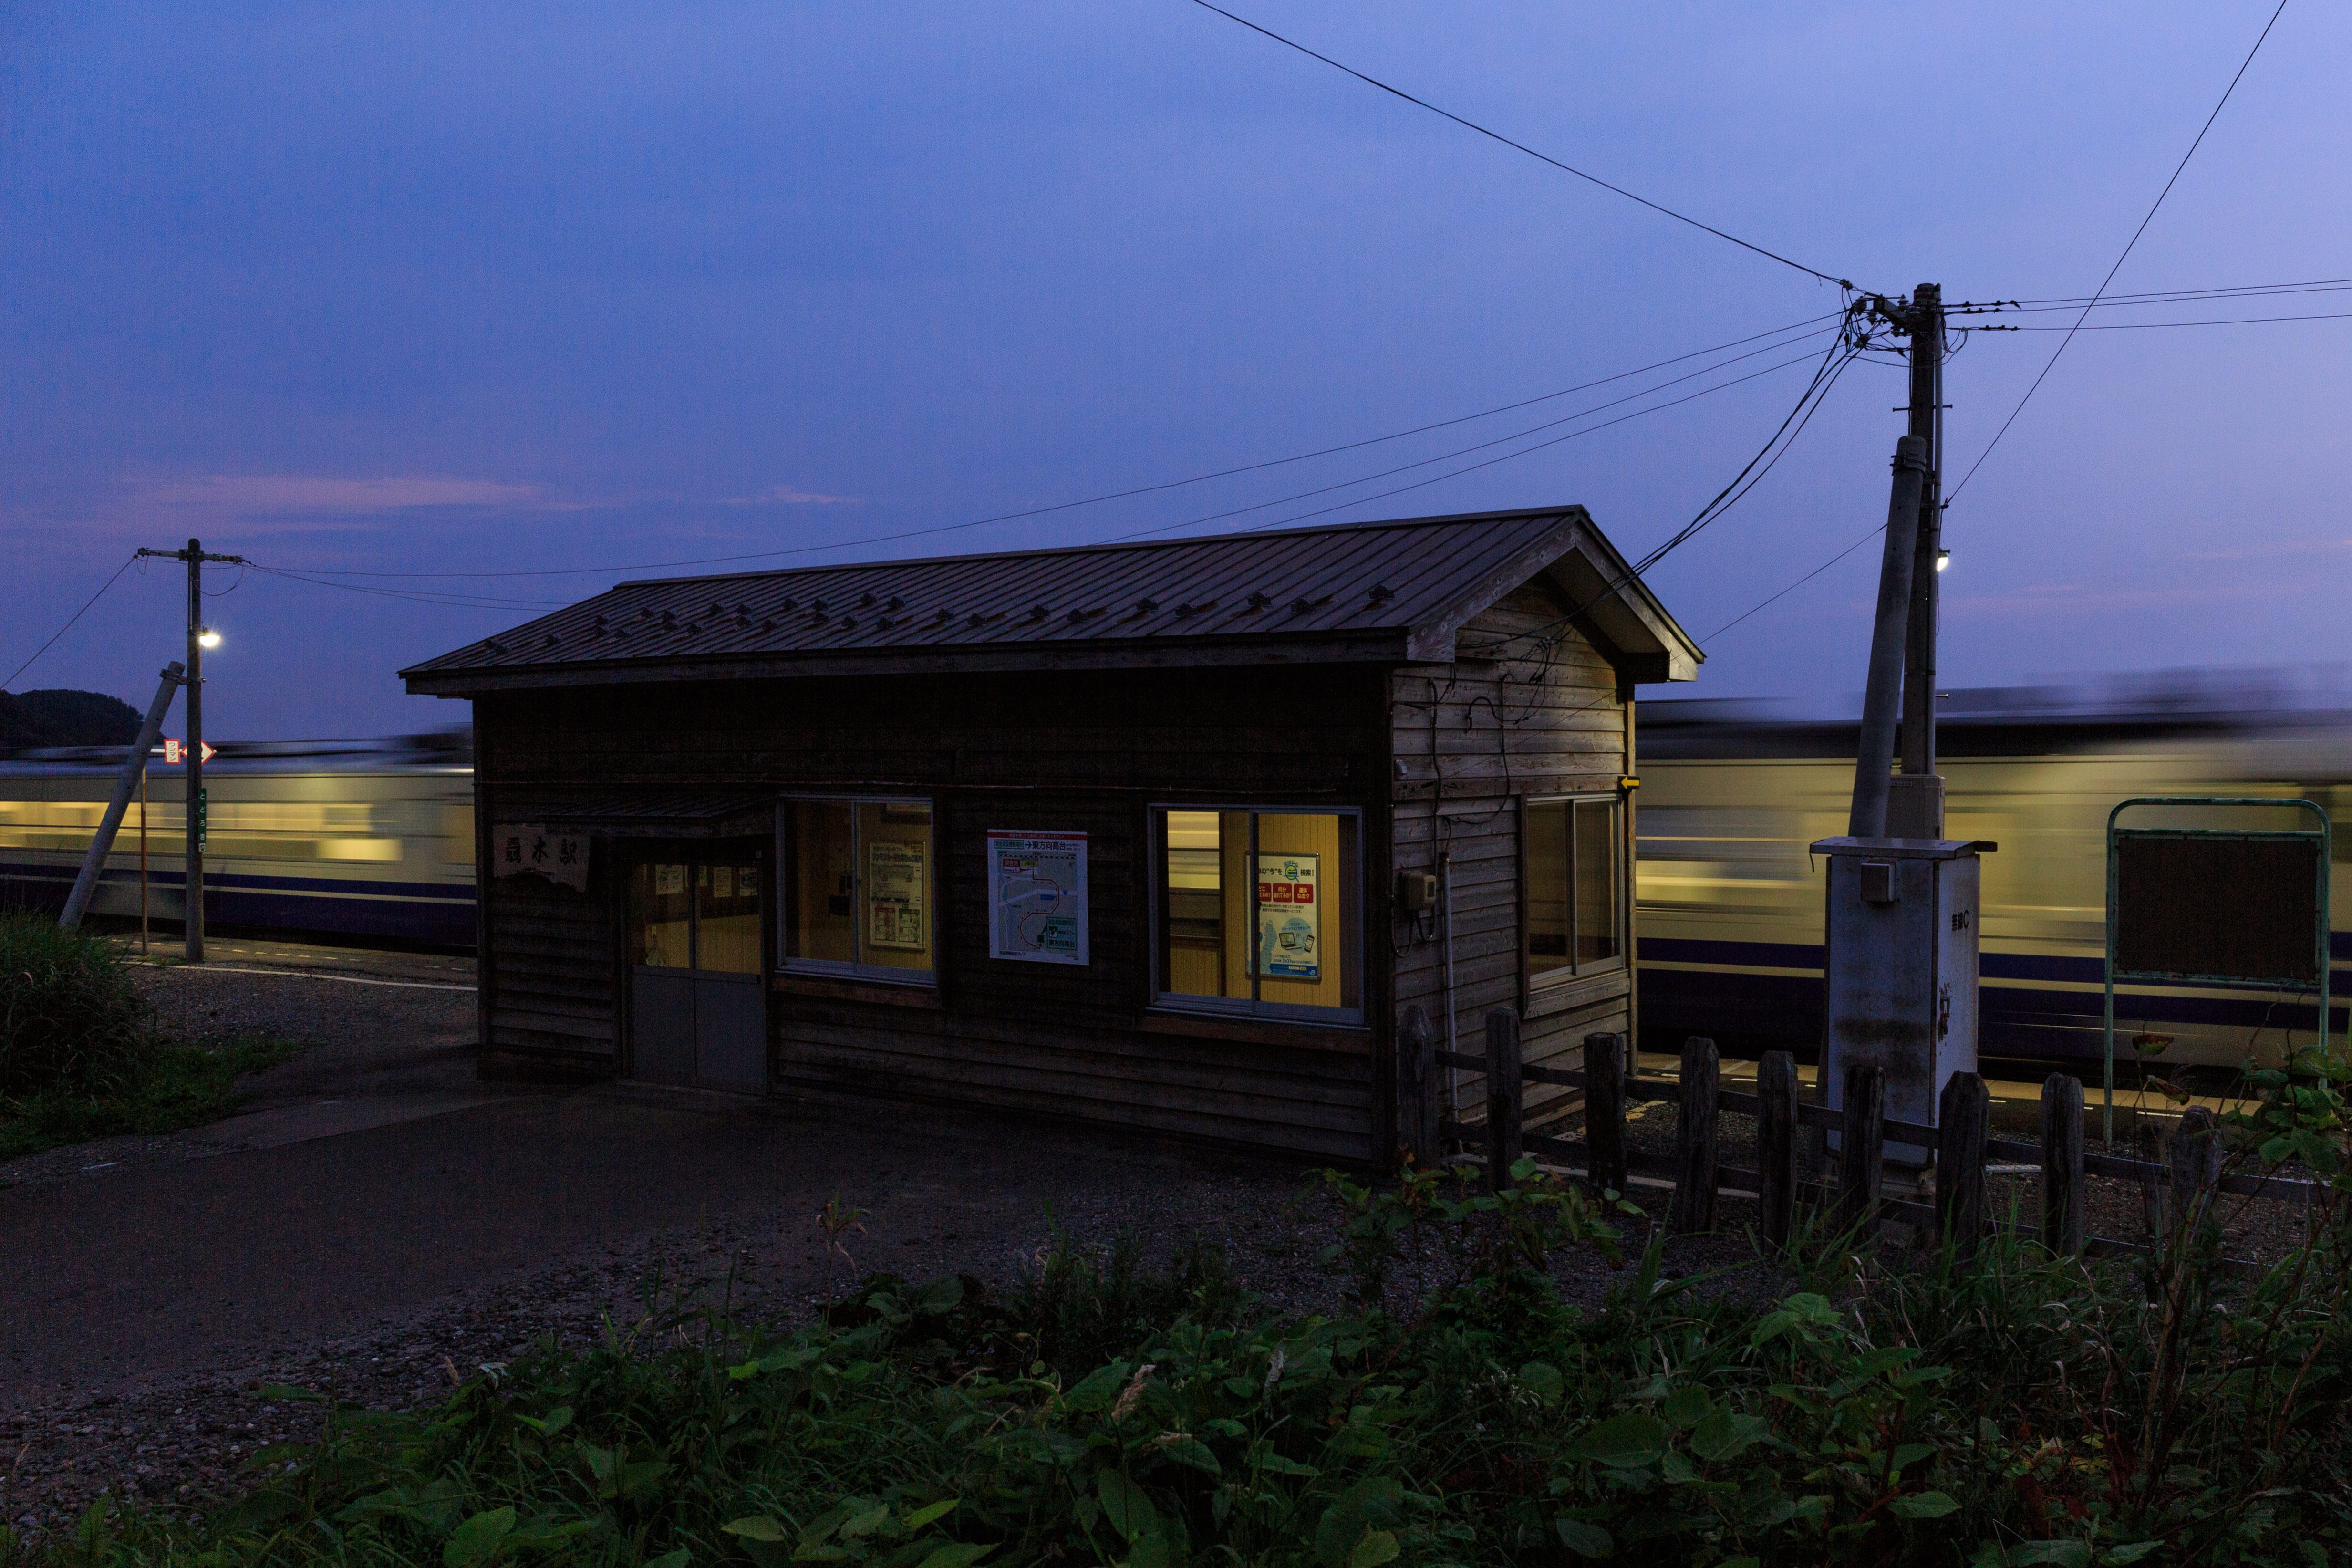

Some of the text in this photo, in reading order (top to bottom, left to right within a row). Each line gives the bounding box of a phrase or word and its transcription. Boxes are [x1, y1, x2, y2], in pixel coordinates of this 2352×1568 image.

[1033, 841, 1066, 850] 東方向高台
